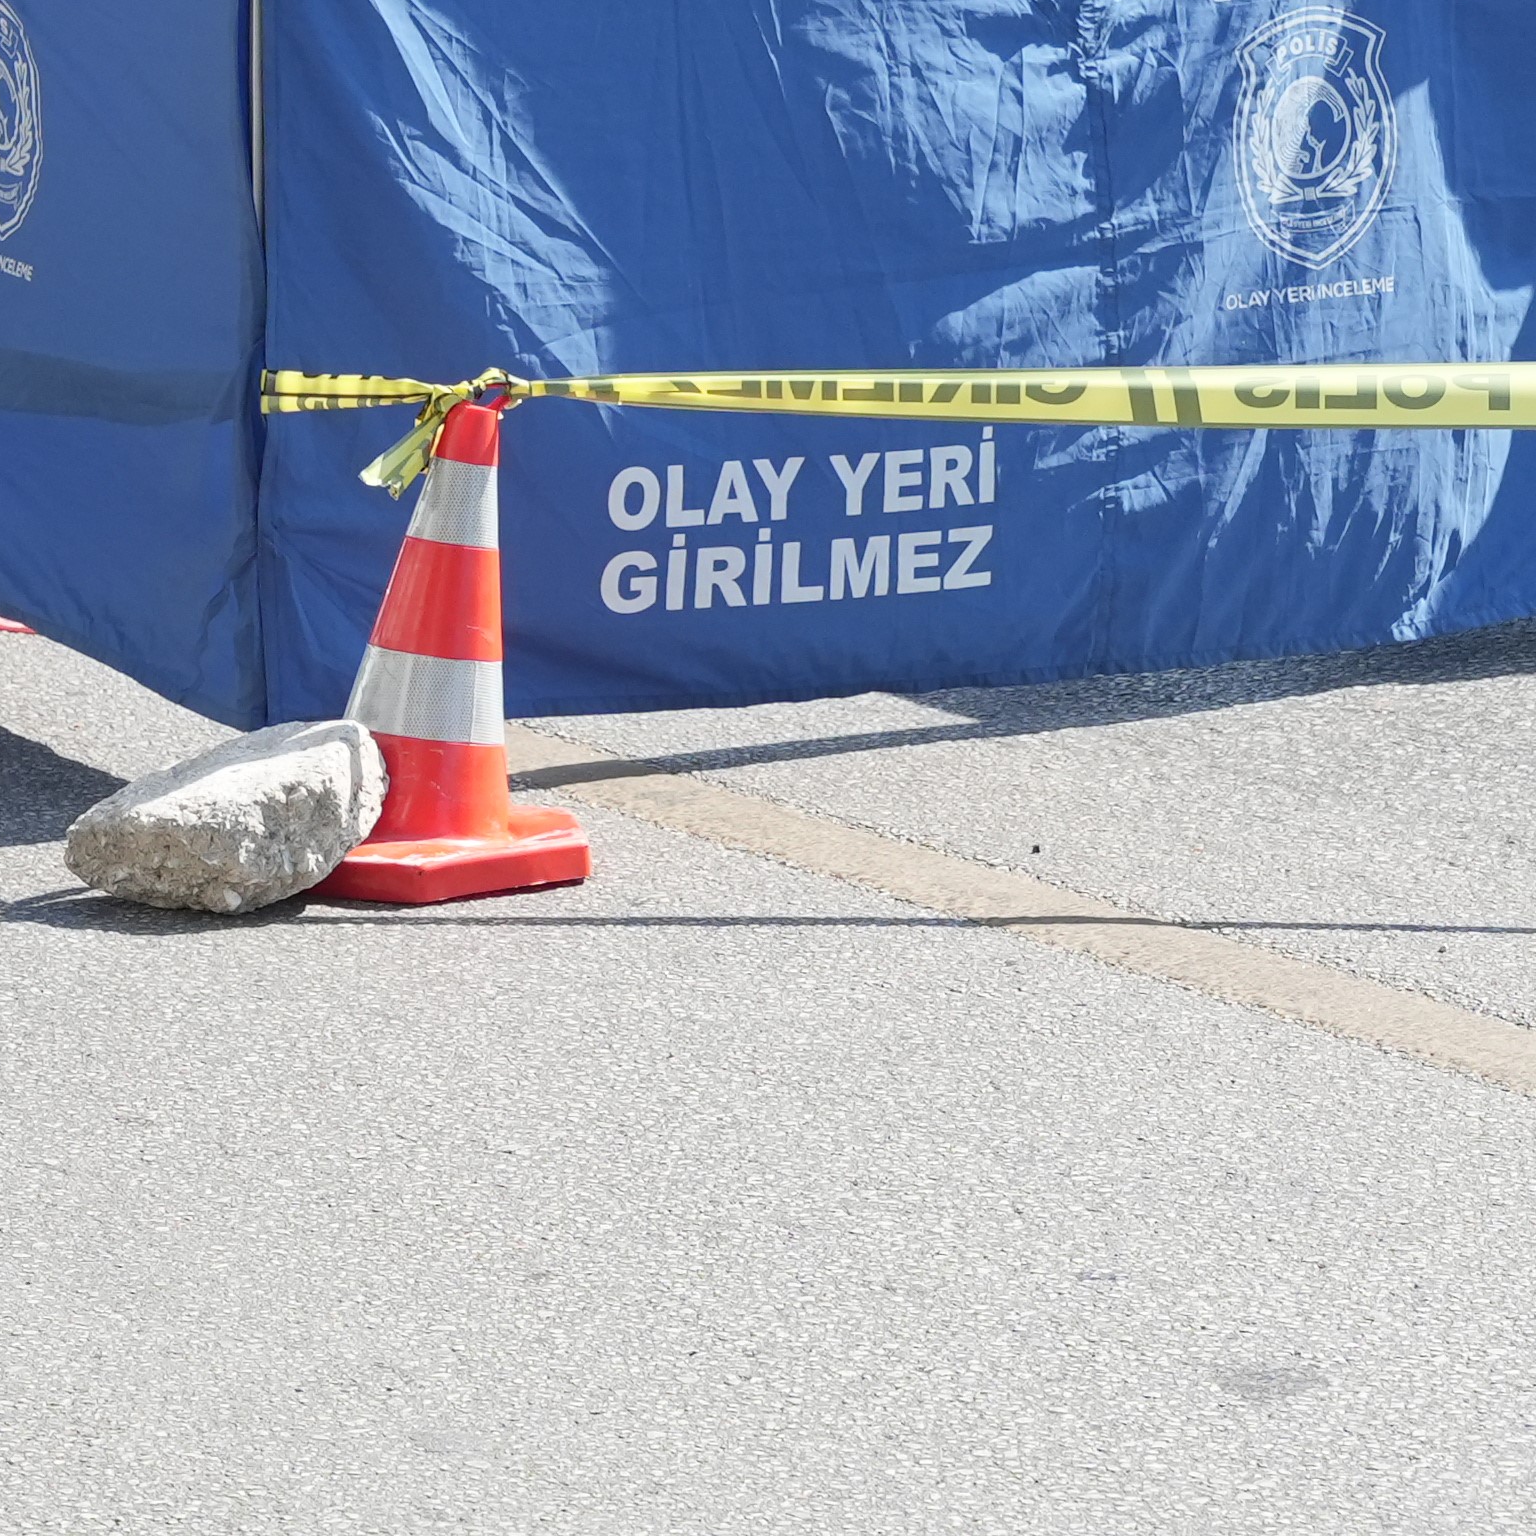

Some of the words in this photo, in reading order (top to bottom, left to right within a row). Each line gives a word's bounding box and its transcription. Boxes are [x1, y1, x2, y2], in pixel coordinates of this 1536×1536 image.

[1226, 290, 1271, 311] OLAY
[607, 456, 805, 532] OLAY
[829, 425, 996, 517] YERİ
[600, 524, 994, 615] GİRİLMEZ
